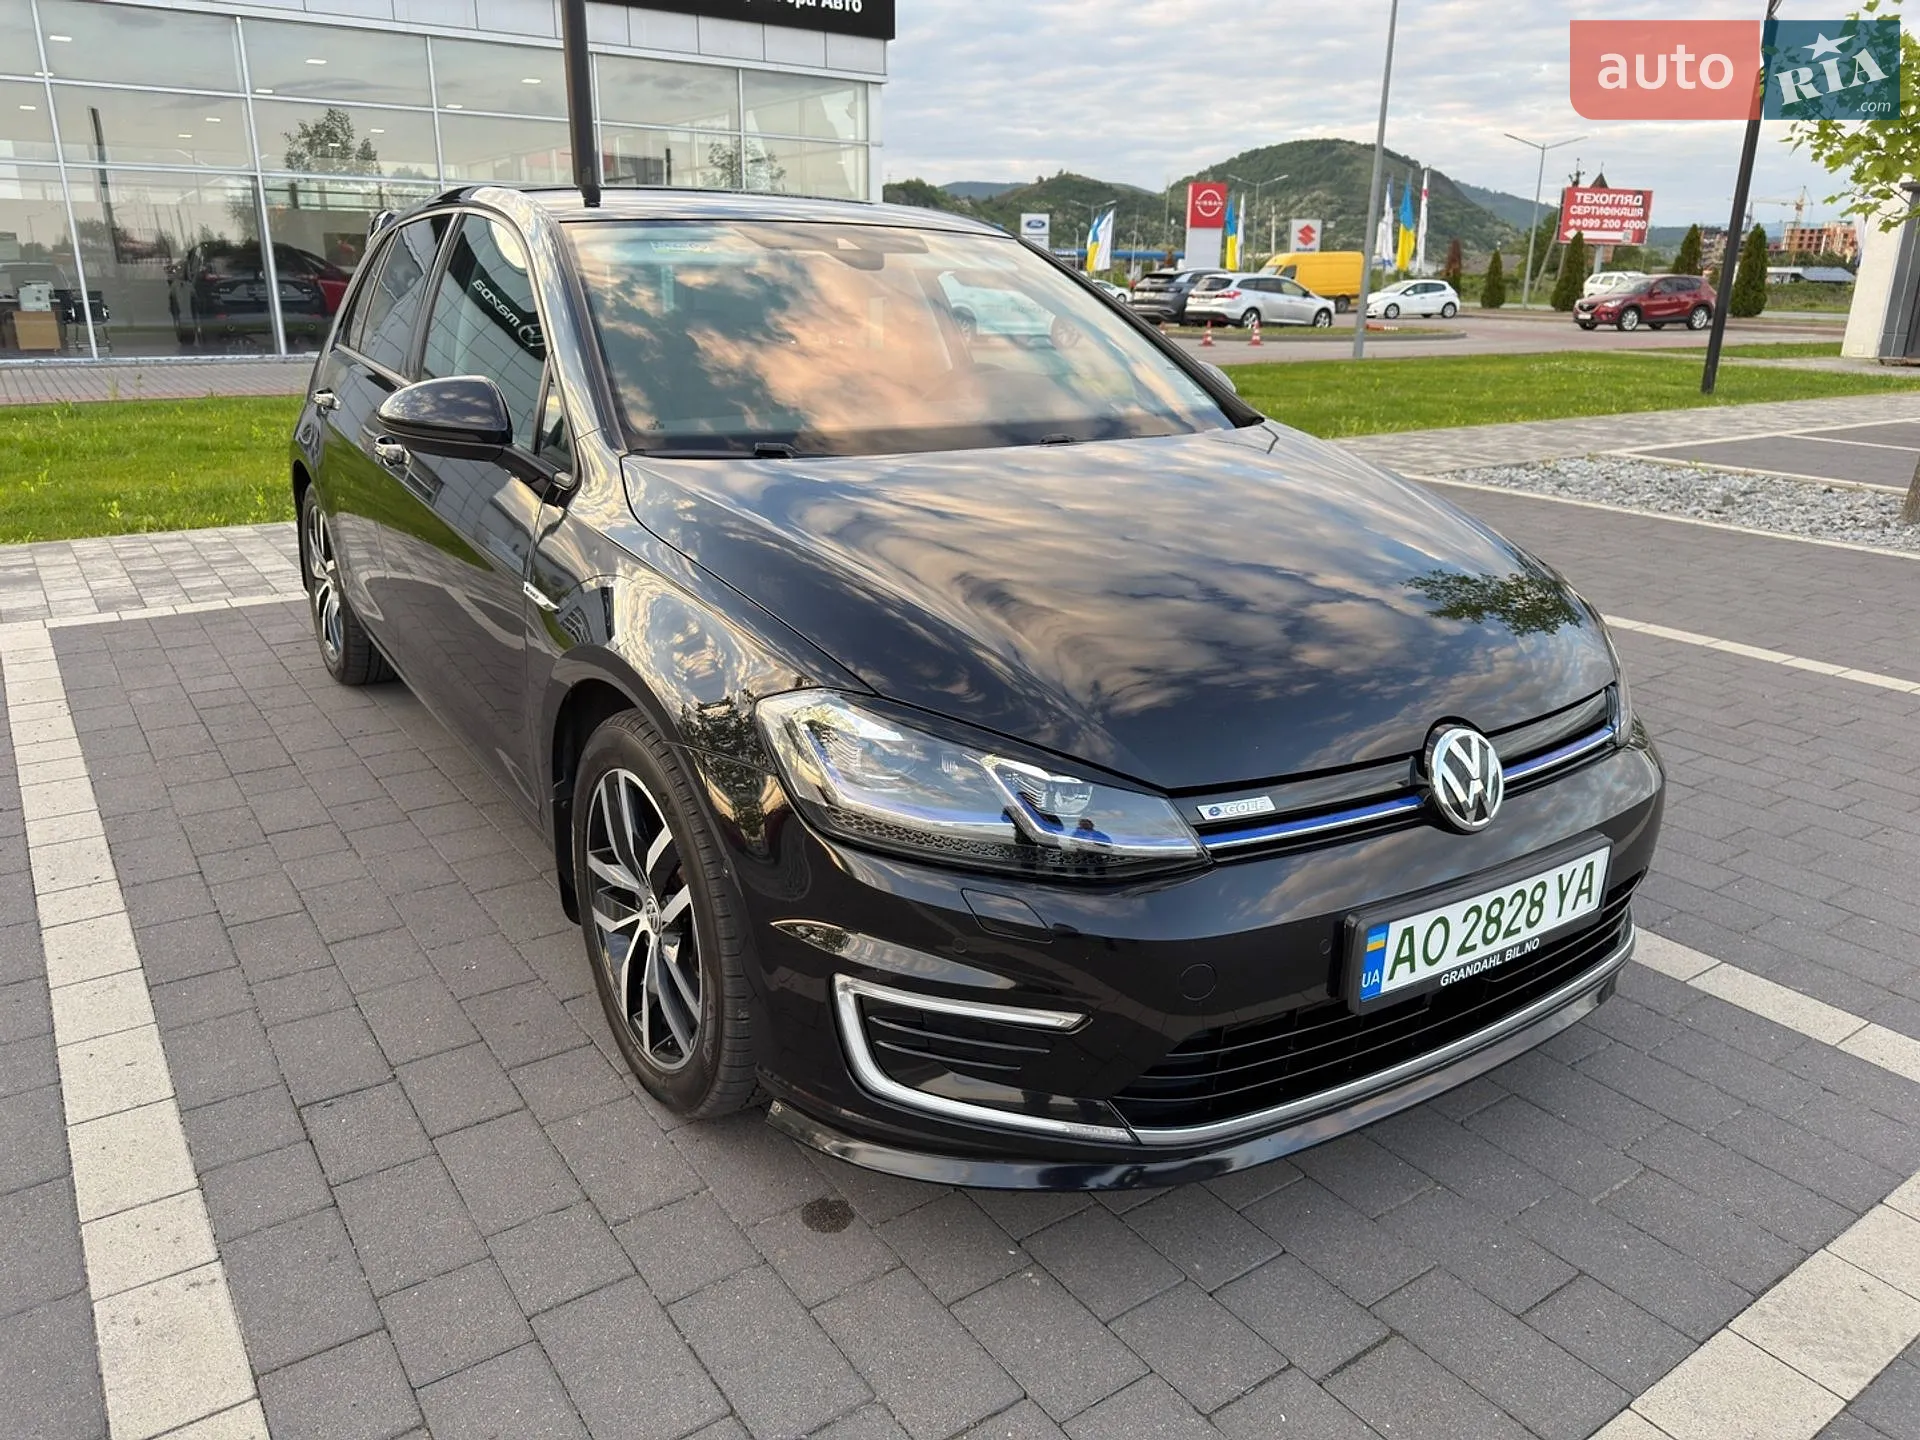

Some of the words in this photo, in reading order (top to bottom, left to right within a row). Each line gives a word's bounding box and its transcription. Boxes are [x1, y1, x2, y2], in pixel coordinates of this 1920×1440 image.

[1575, 191, 1643, 206] ТЕХОГЛЯД
[1602, 219, 1621, 229] 200
[1623, 220, 1647, 230] 4000
[1387, 915, 1451, 981] AO
[1456, 880, 1547, 957] 2828
[1556, 860, 1595, 918] YA
[1440, 953, 1503, 987] GRANDAHL
[1504, 937, 1540, 962] BIL.NO
[1362, 968, 1380, 988] UA
